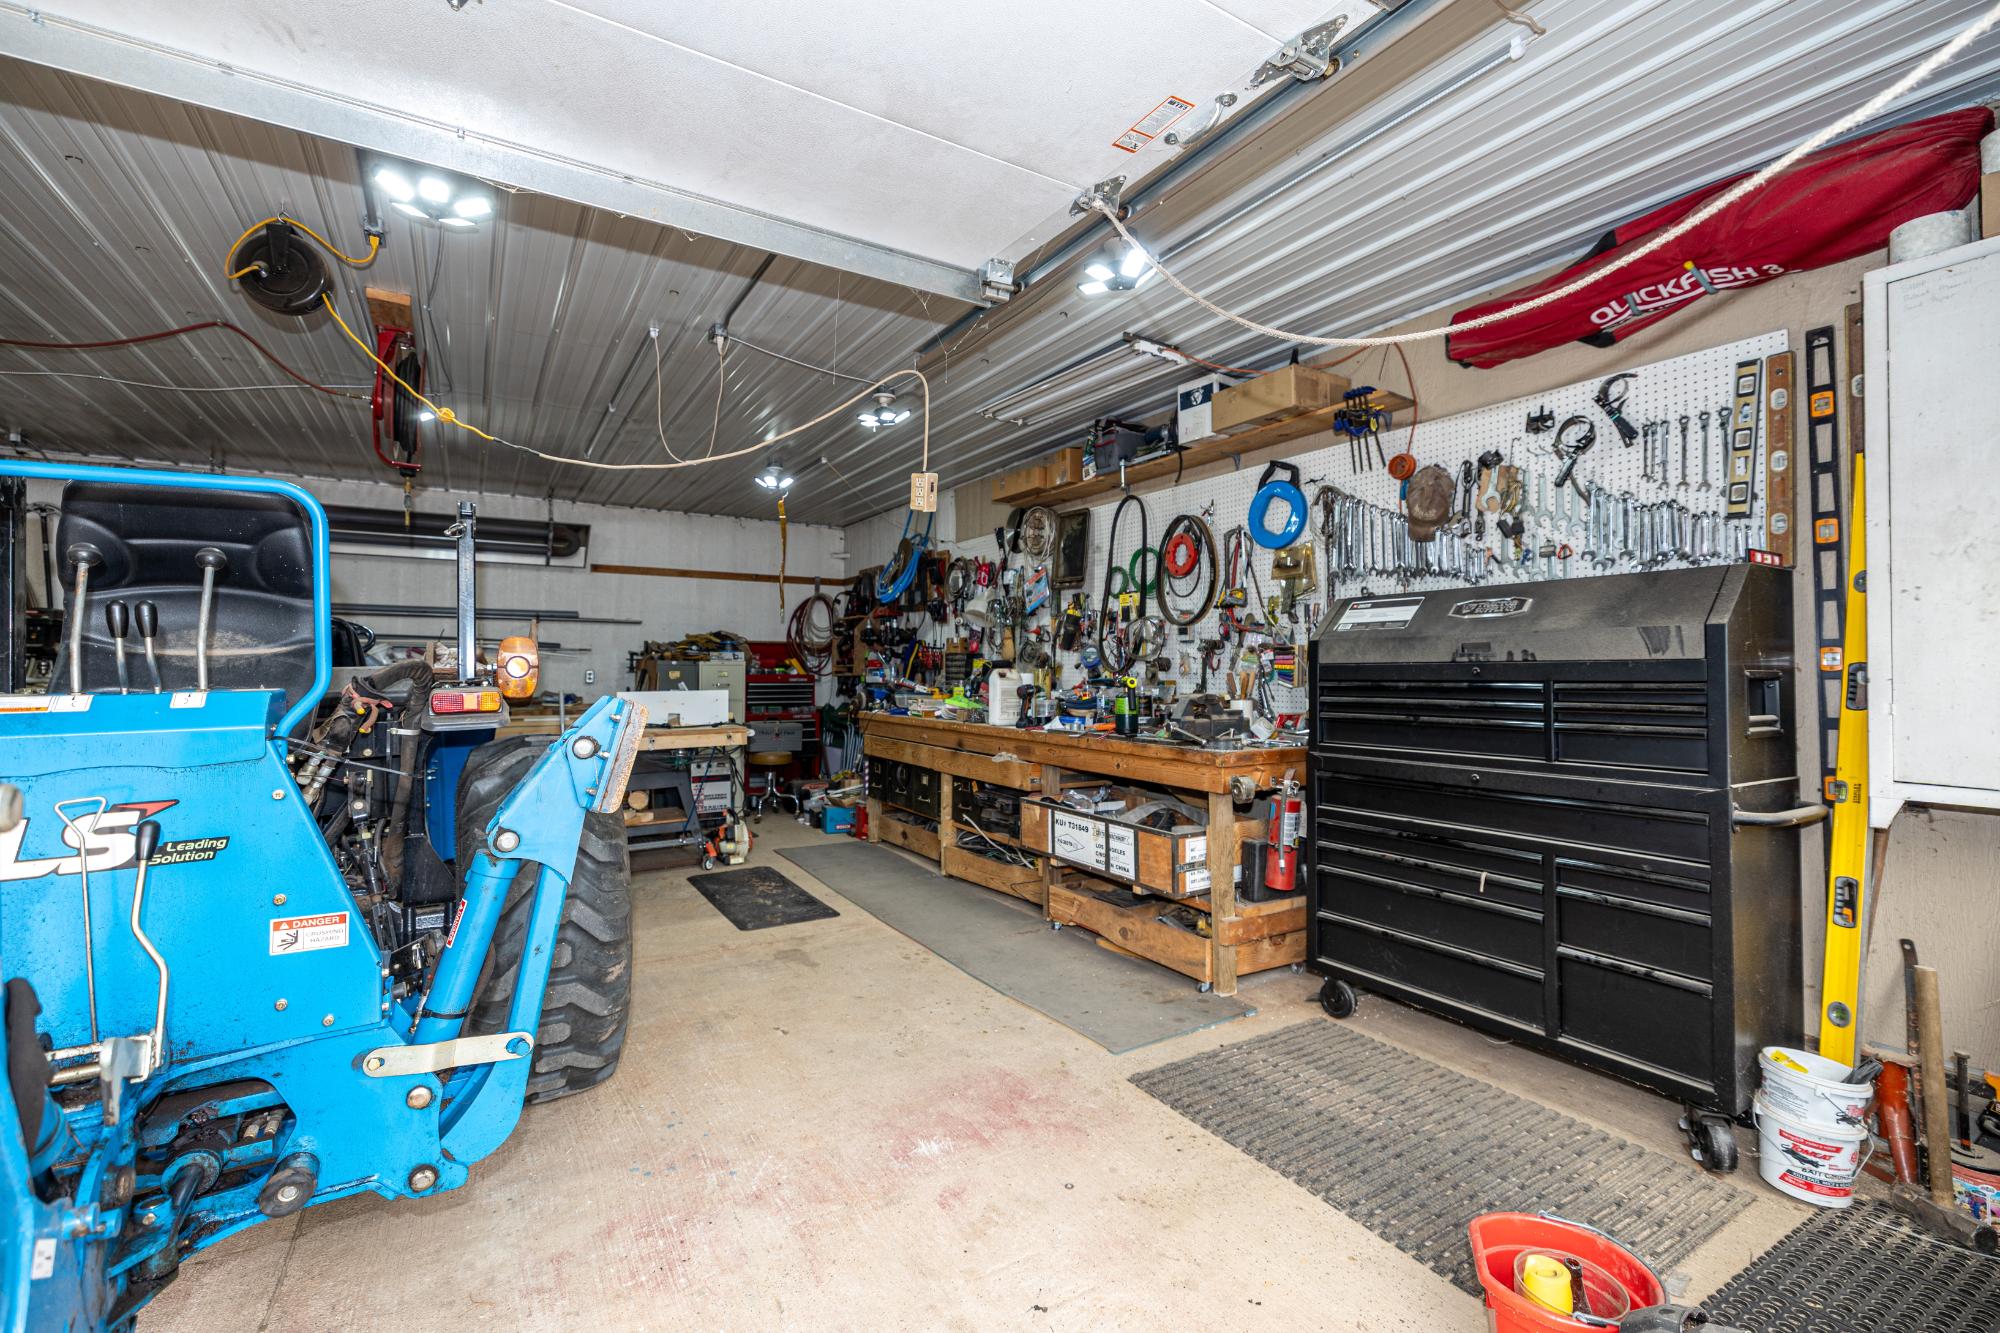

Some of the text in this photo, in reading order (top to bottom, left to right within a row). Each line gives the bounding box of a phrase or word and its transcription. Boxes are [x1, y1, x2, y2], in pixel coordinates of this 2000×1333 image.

[166, 837, 227, 852] Leading
[148, 849, 214, 865] Solution
[1115, 864, 1130, 873] CHINA
[292, 916, 340, 929] DANGER
[1790, 1142, 1834, 1161] TOMCAT
